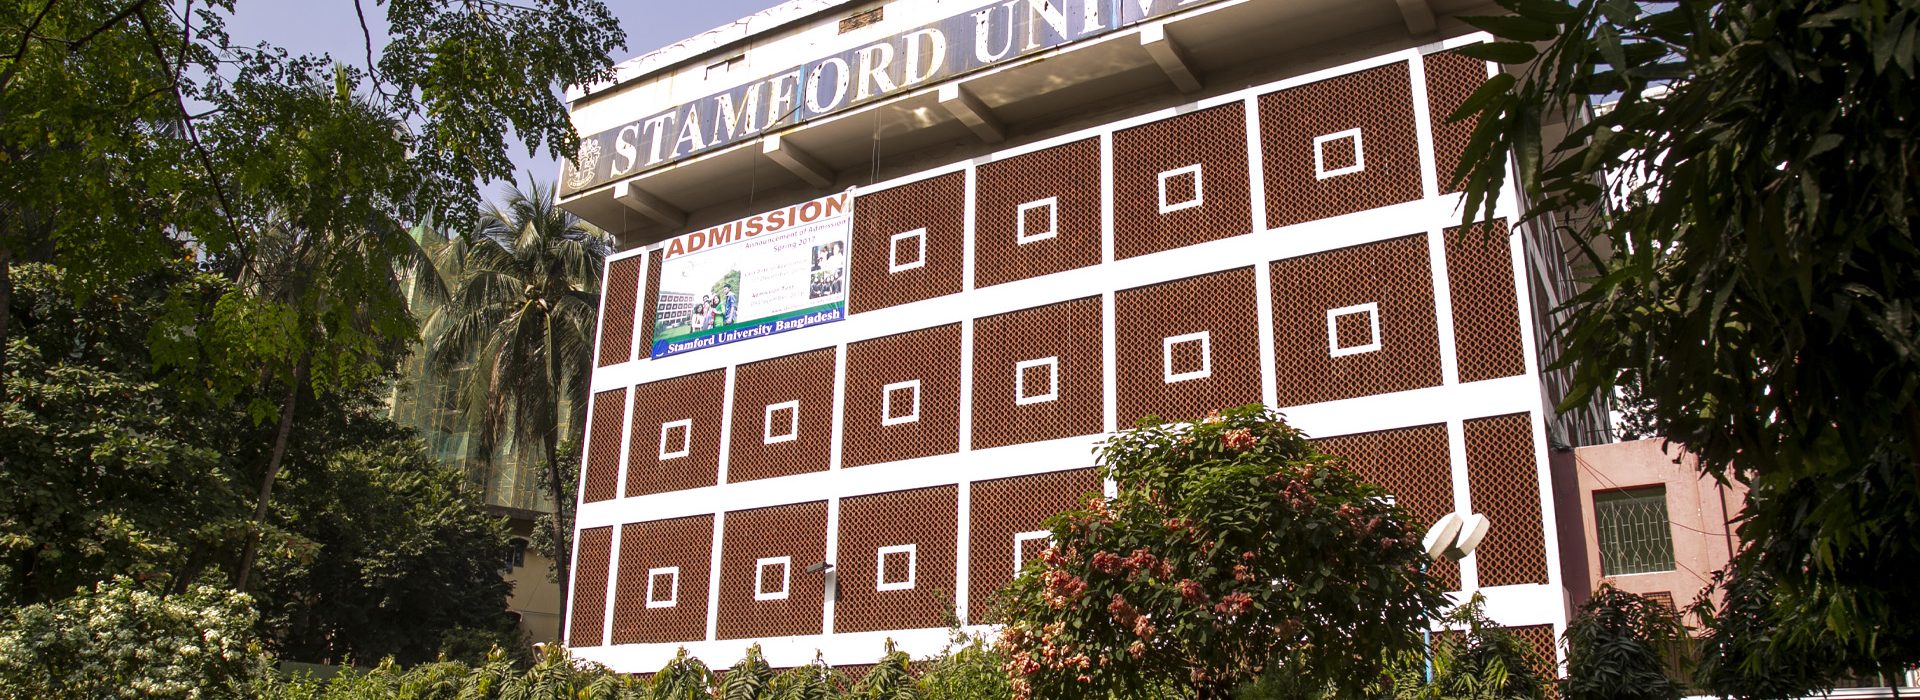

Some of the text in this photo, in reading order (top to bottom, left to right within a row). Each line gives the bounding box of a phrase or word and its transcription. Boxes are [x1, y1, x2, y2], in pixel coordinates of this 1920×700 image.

[609, 28, 947, 178] STAMFORD
[665, 193, 849, 260] ADMISSION
[745, 230, 798, 249] Announcement
[808, 219, 847, 234] Admission
[773, 242, 797, 253] Spring
[667, 309, 840, 354] Stamford University Bangladesh
